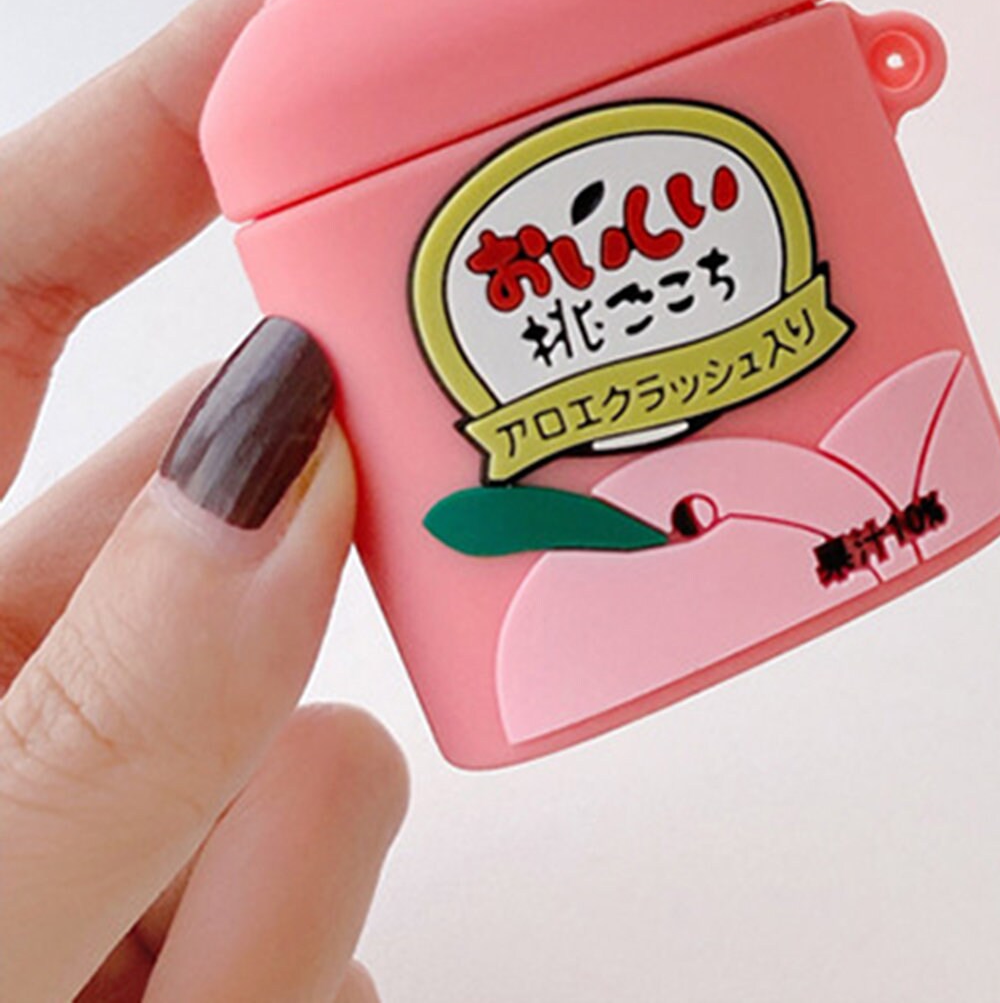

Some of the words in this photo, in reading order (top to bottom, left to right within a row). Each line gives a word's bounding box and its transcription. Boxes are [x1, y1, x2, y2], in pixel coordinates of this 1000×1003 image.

[465, 164, 739, 313] おいしい
[496, 307, 816, 458] アロエクラッシュ入り
